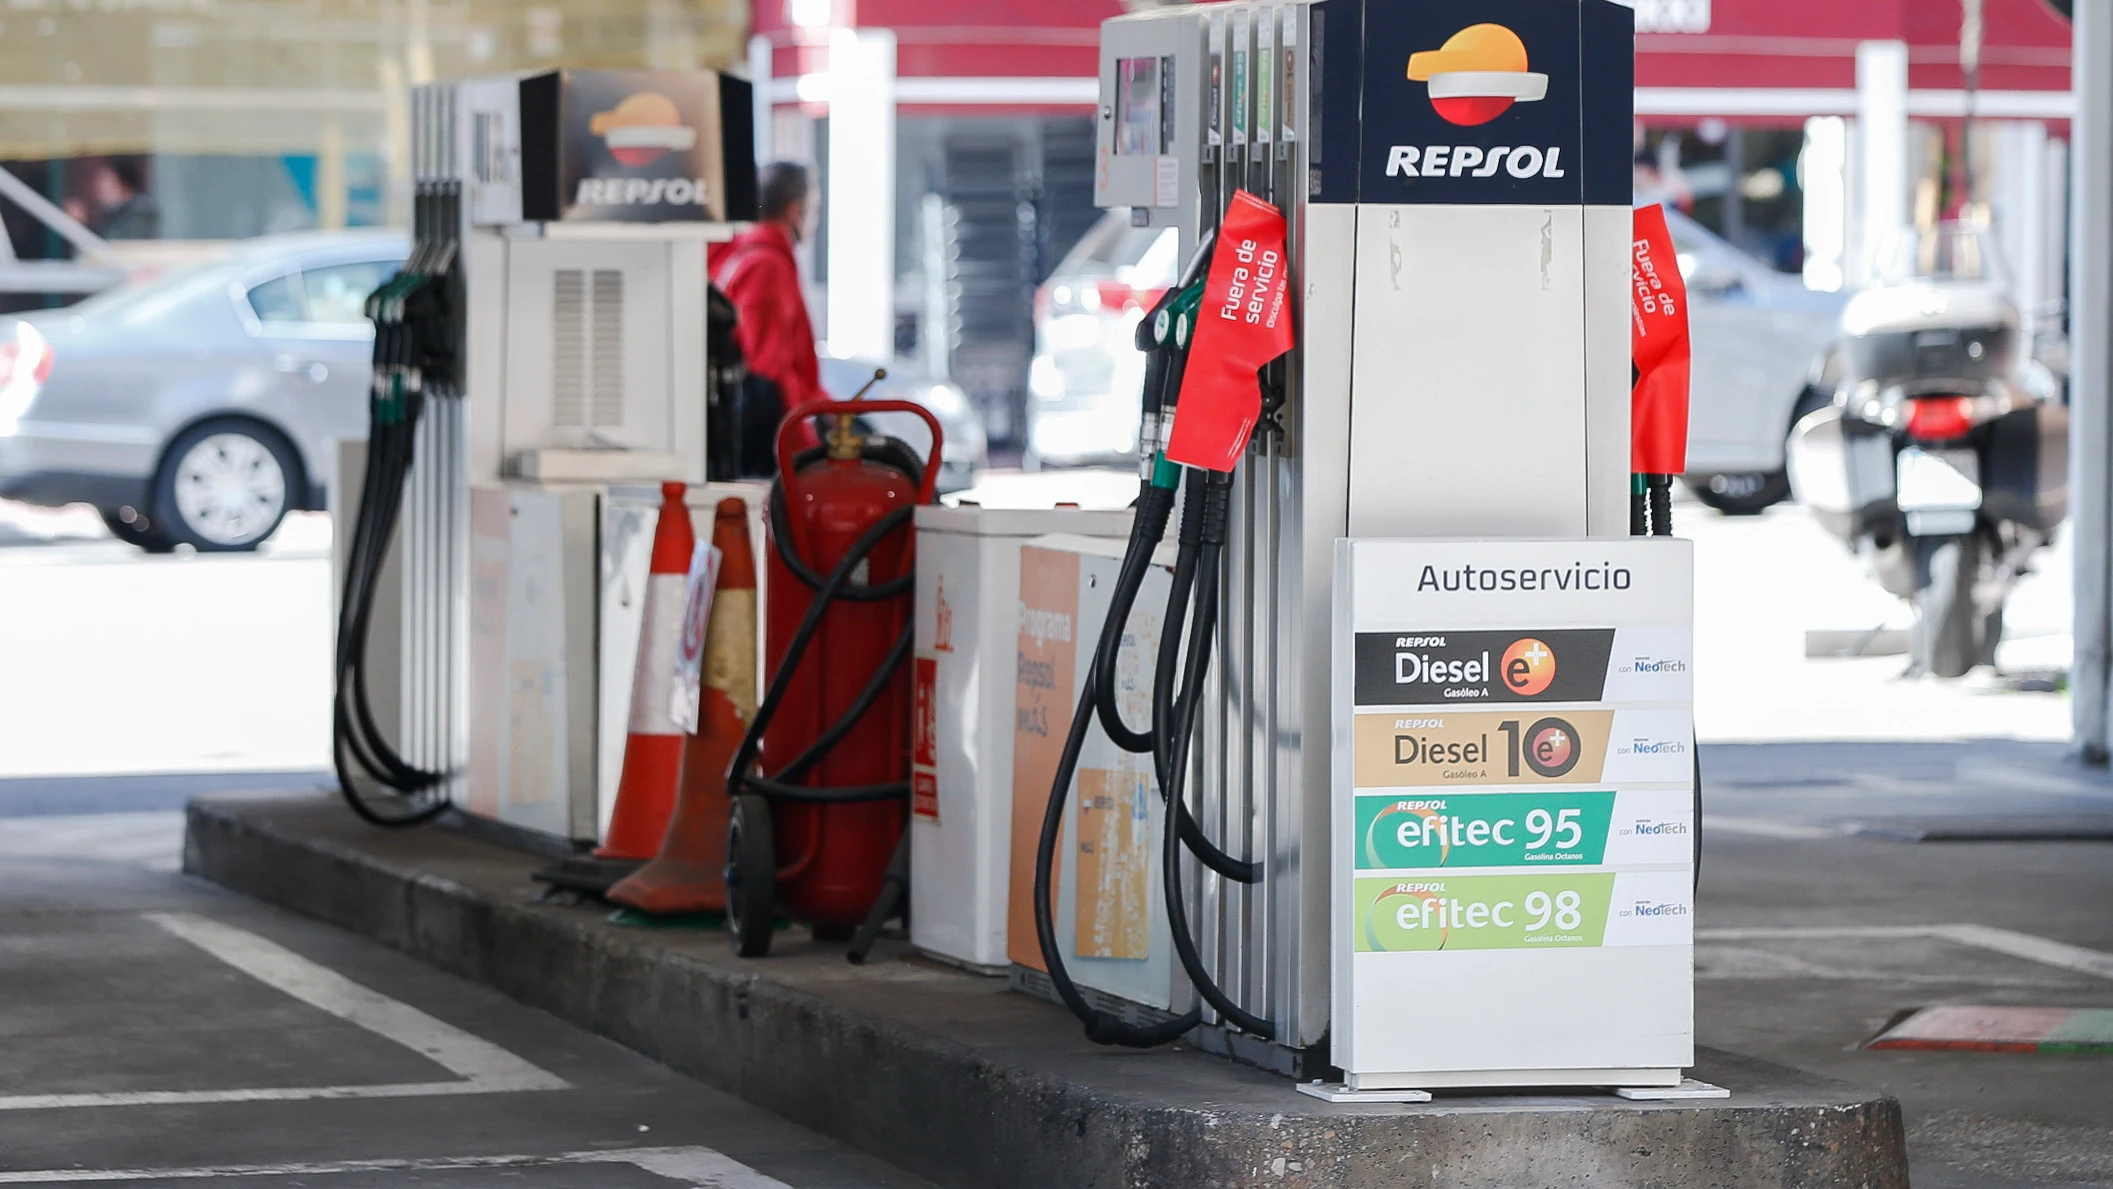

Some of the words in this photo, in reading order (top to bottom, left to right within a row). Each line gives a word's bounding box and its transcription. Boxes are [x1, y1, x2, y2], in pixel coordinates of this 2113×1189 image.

[1386, 146, 1565, 179] REPSOL
[575, 178, 708, 205] REPSOL
[1221, 267, 1249, 320] Fuera
[1236, 239, 1257, 264] de
[1633, 239, 1662, 290] Fuera
[1658, 292, 1676, 316] de
[1246, 250, 1278, 325] servicio
[1417, 561, 1631, 592] Autoservicio
[1018, 602, 1071, 648] Programa
[1395, 636, 1446, 648] REPSOL
[1395, 650, 1490, 684] Diesel
[1618, 665, 1632, 673] con
[1634, 659, 1686, 672] NeoTech
[1443, 687, 1480, 699] Gasóleo
[1481, 687, 1489, 697] A
[1394, 718, 1444, 729] REPSOL
[1394, 733, 1488, 765] Diesel
[1497, 716, 1581, 778] 10
[1617, 746, 1631, 755] con
[1633, 741, 1685, 754] NeoTech
[1442, 769, 1478, 779] Gasóleo
[1480, 769, 1488, 779] A
[1397, 800, 1447, 811] REPSOL
[1396, 815, 1515, 848] efitec
[1524, 808, 1583, 850] 95
[1619, 828, 1633, 836] con
[1635, 822, 1687, 835] NeoTech
[1524, 853, 1554, 862] Gasolina
[1555, 852, 1583, 861] Octanos
[1396, 882, 1446, 893] REPSOL
[1396, 898, 1514, 930] efitec
[1524, 890, 1582, 932] 98
[1619, 909, 1633, 918] con
[1635, 903, 1687, 916] NeoTech
[1523, 934, 1553, 943] Gasolina
[1554, 934, 1583, 943] Octanos
